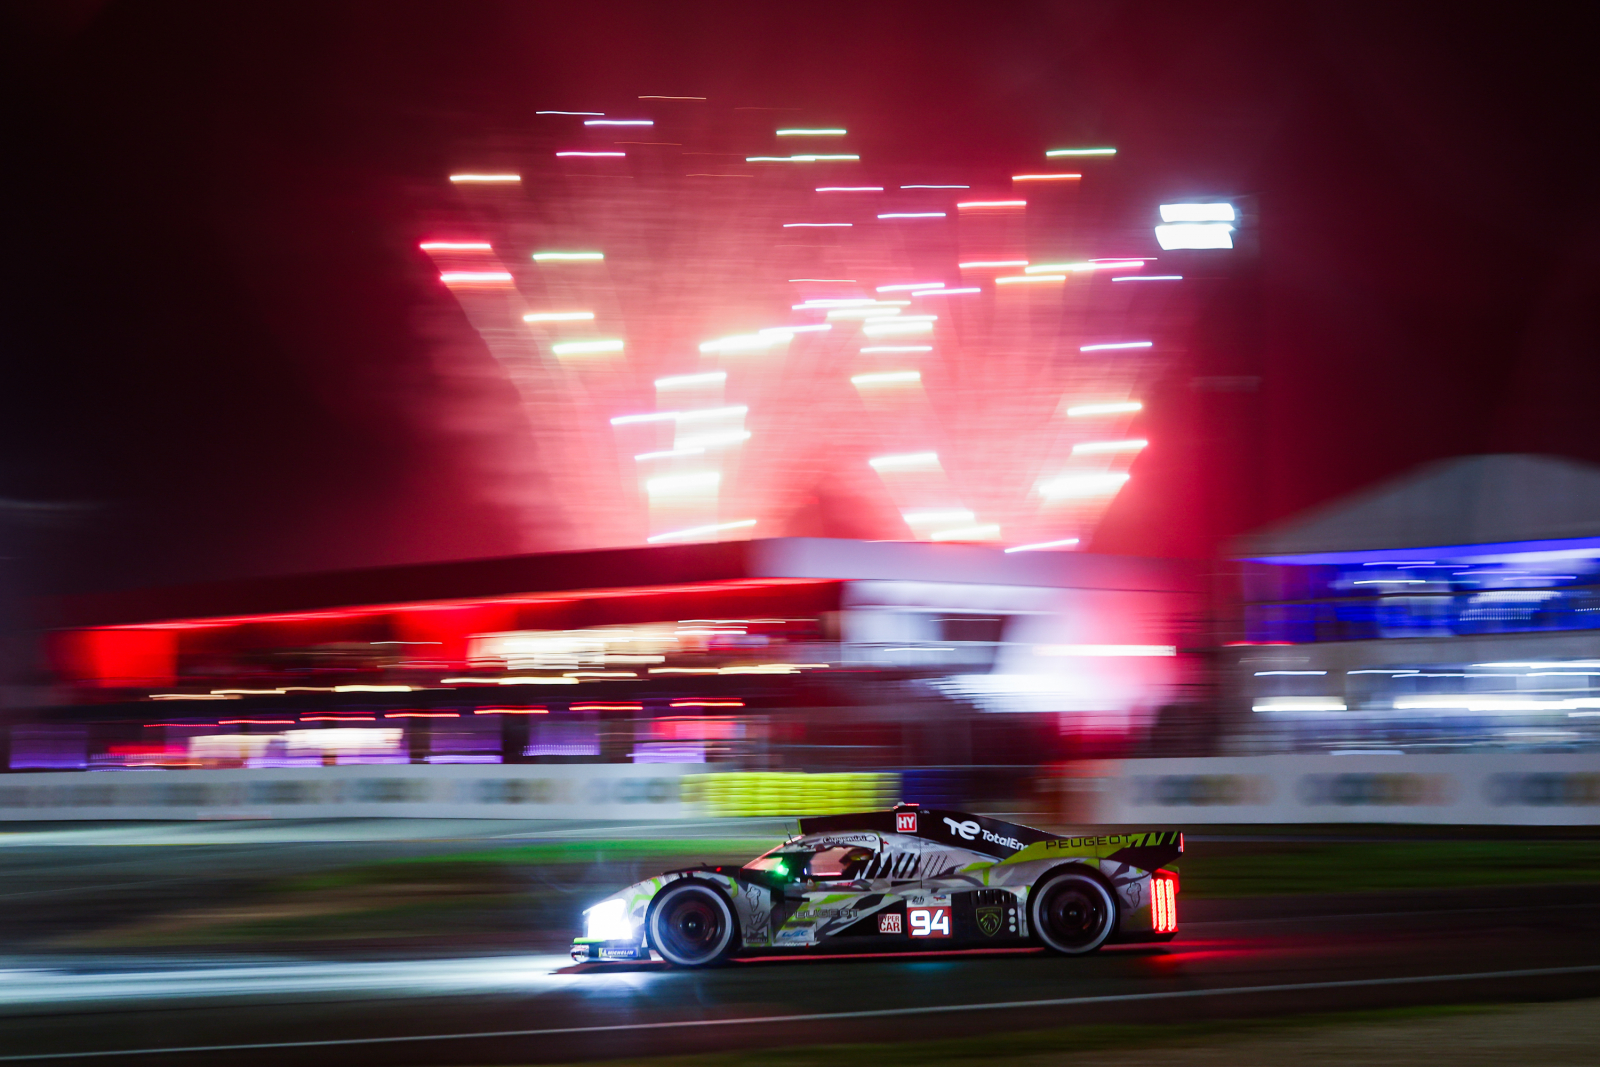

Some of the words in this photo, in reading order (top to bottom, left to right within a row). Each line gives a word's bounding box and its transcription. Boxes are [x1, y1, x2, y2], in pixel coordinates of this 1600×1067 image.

[898, 816, 915, 829] HY
[1045, 833, 1132, 850] PEUGEOT
[880, 922, 900, 932] CAR
[910, 909, 950, 936] 94
